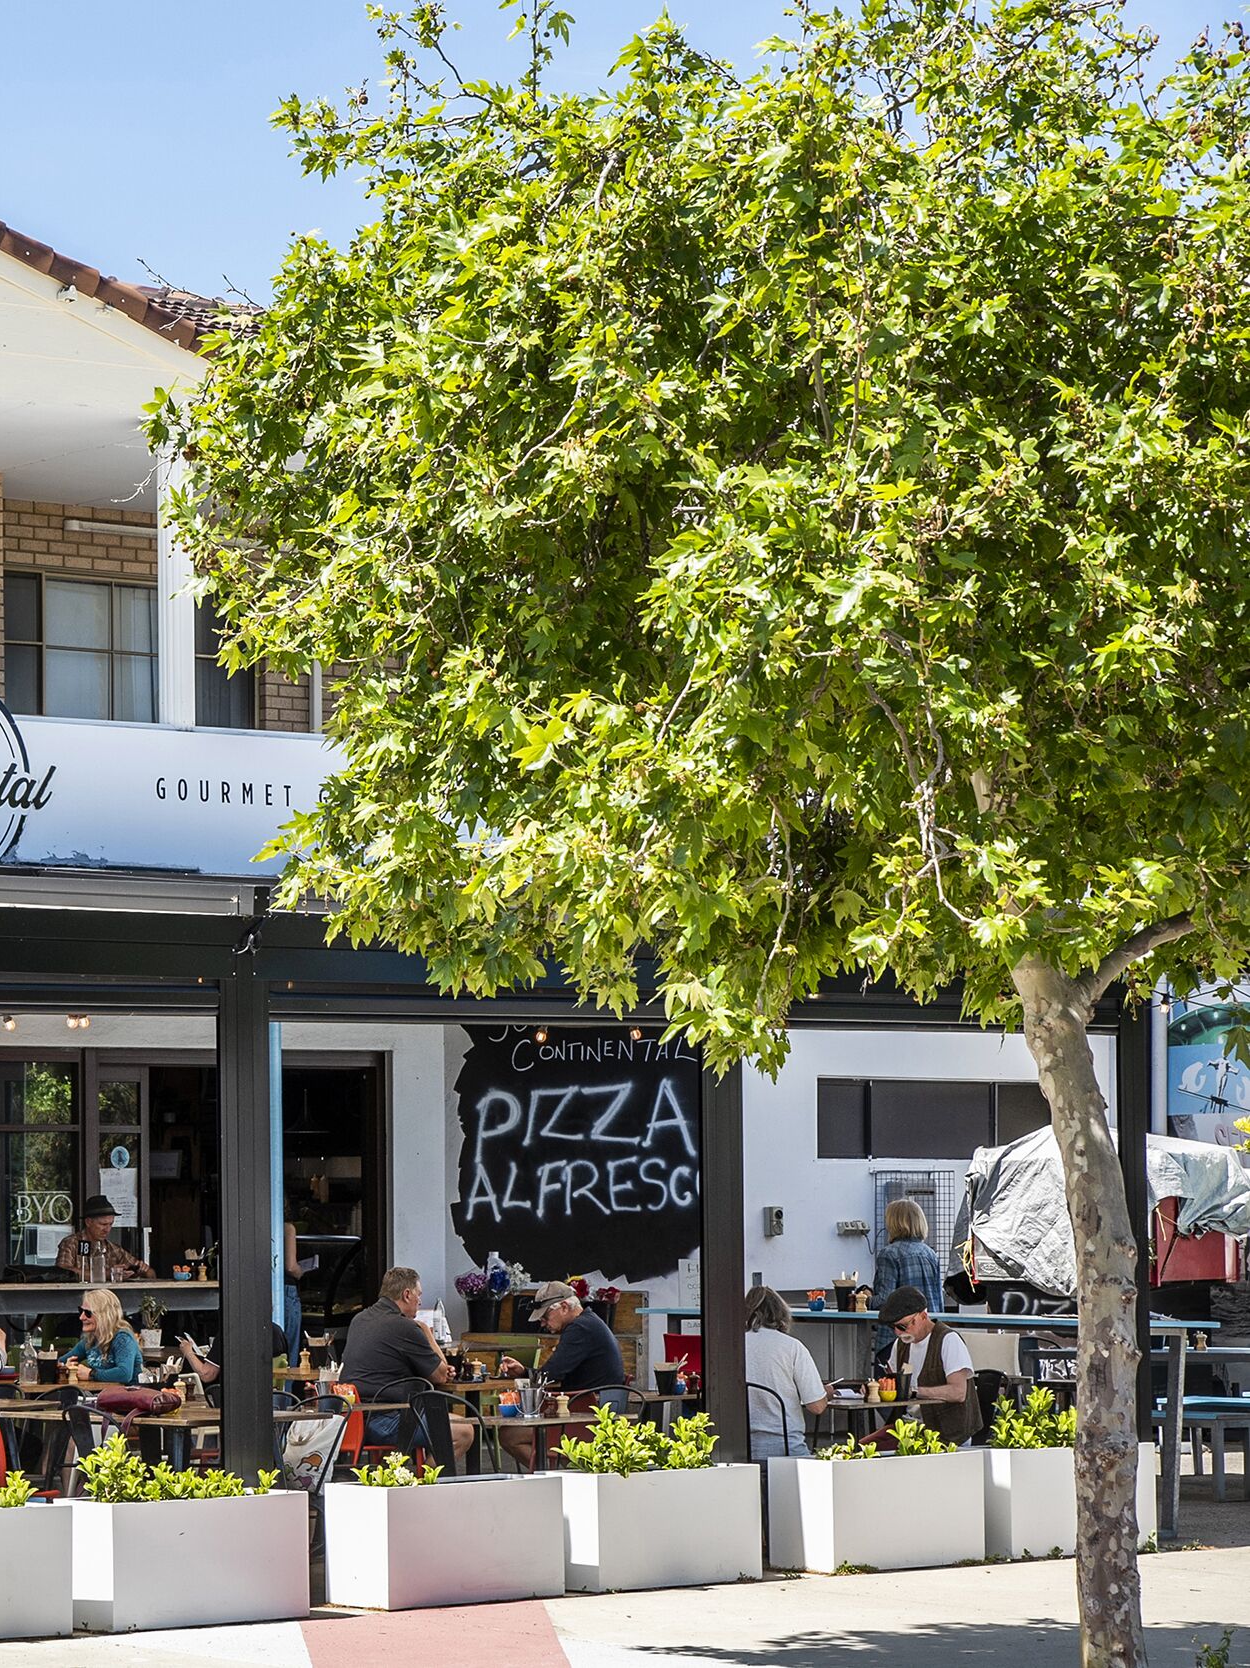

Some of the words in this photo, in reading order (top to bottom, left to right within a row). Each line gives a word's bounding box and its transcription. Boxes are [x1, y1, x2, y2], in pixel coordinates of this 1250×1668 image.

[156, 777, 292, 807] GOURMET
[511, 1037, 698, 1072] CONTINENTAL
[476, 1077, 696, 1164] PIZZA
[466, 1155, 700, 1222] ALFRESC
[17, 1194, 73, 1223] BYO
[80, 1242, 90, 1253] 18
